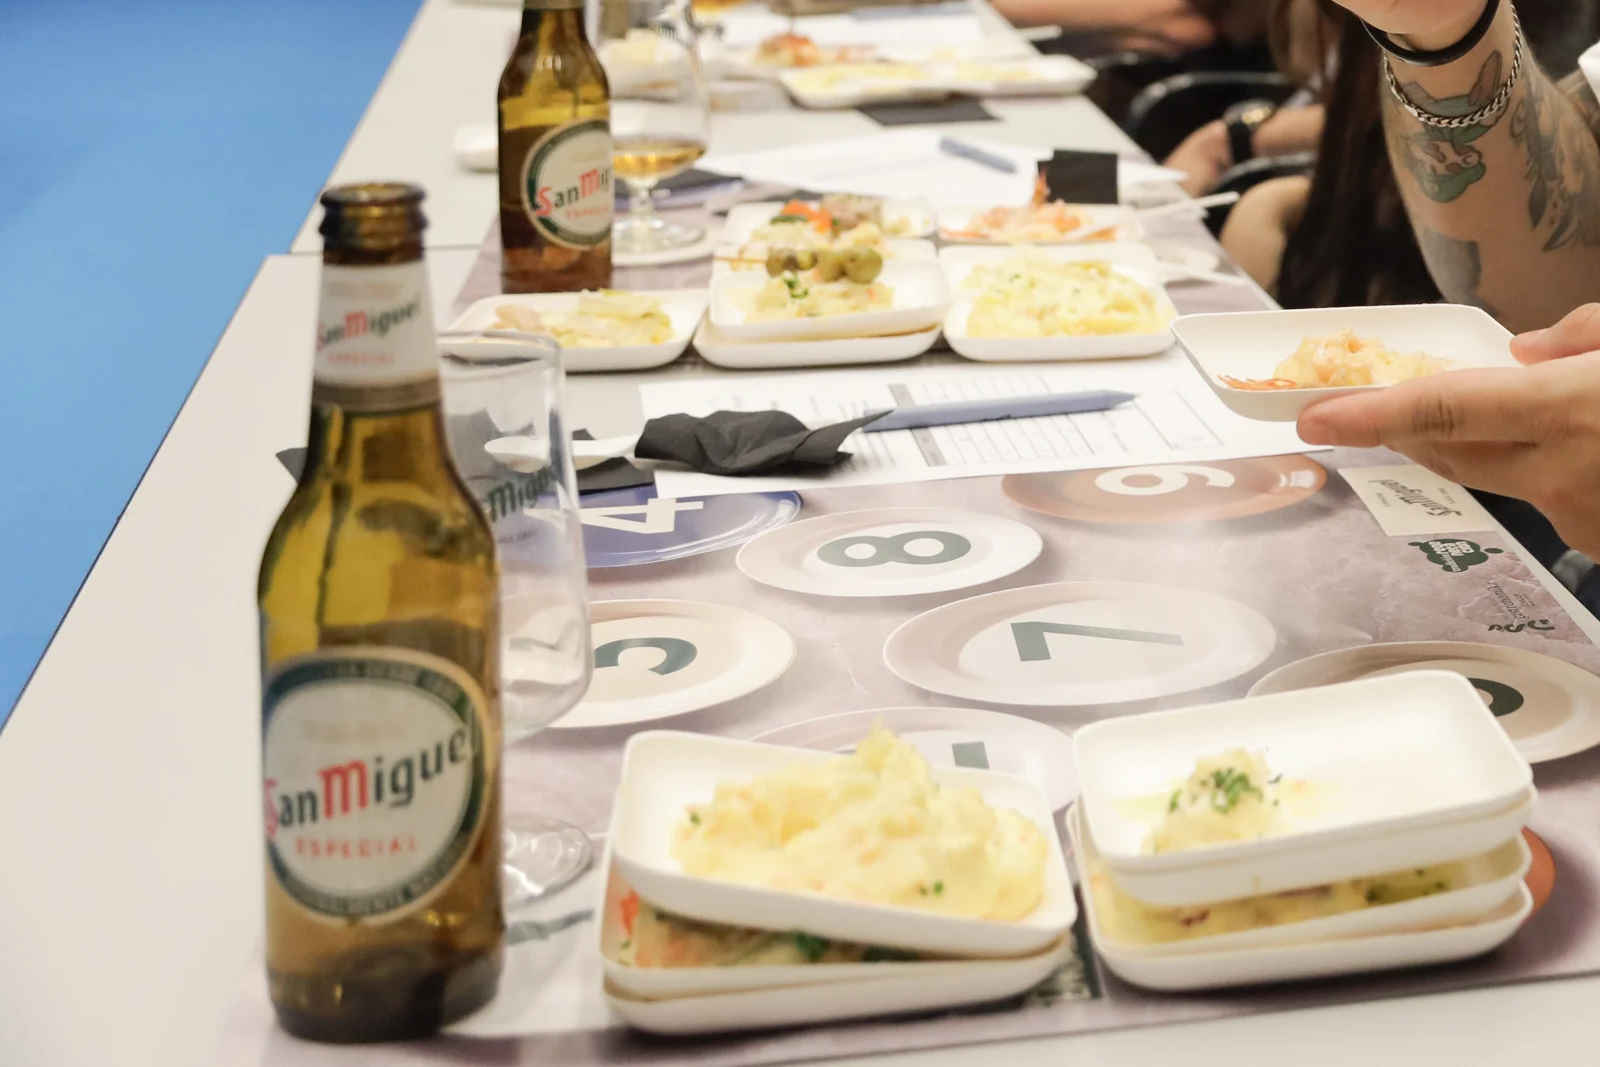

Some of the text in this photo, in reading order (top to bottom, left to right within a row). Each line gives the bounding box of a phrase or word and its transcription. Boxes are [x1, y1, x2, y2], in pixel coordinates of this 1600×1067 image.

[523, 497, 704, 535] 4
[816, 530, 972, 568] 8
[1009, 620, 1185, 663] 7
